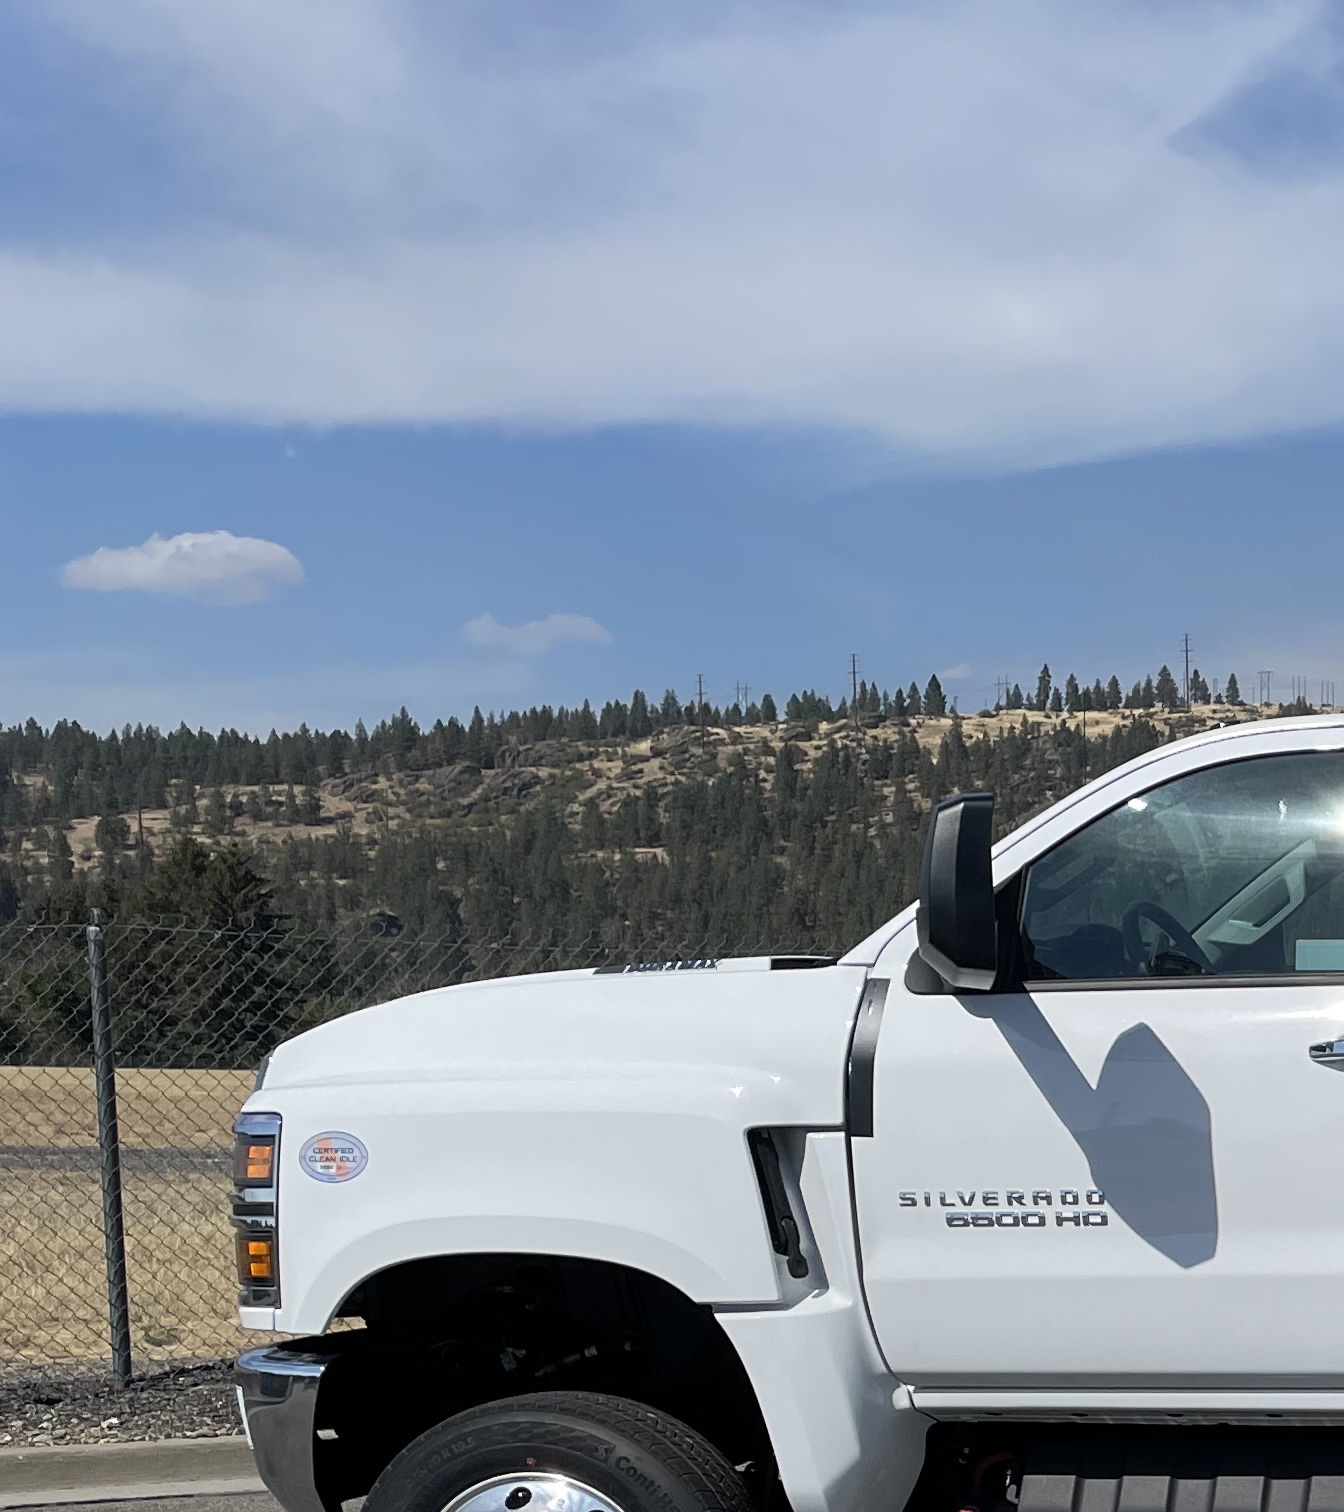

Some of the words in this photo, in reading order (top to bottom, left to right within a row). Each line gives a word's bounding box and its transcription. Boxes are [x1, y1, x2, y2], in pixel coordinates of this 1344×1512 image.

[313, 1147, 354, 1155] CERTIFIED
[899, 1189, 1106, 1207] SILVERADO
[945, 1210, 1047, 1227] 6500
[1055, 1210, 1109, 1227] HD
